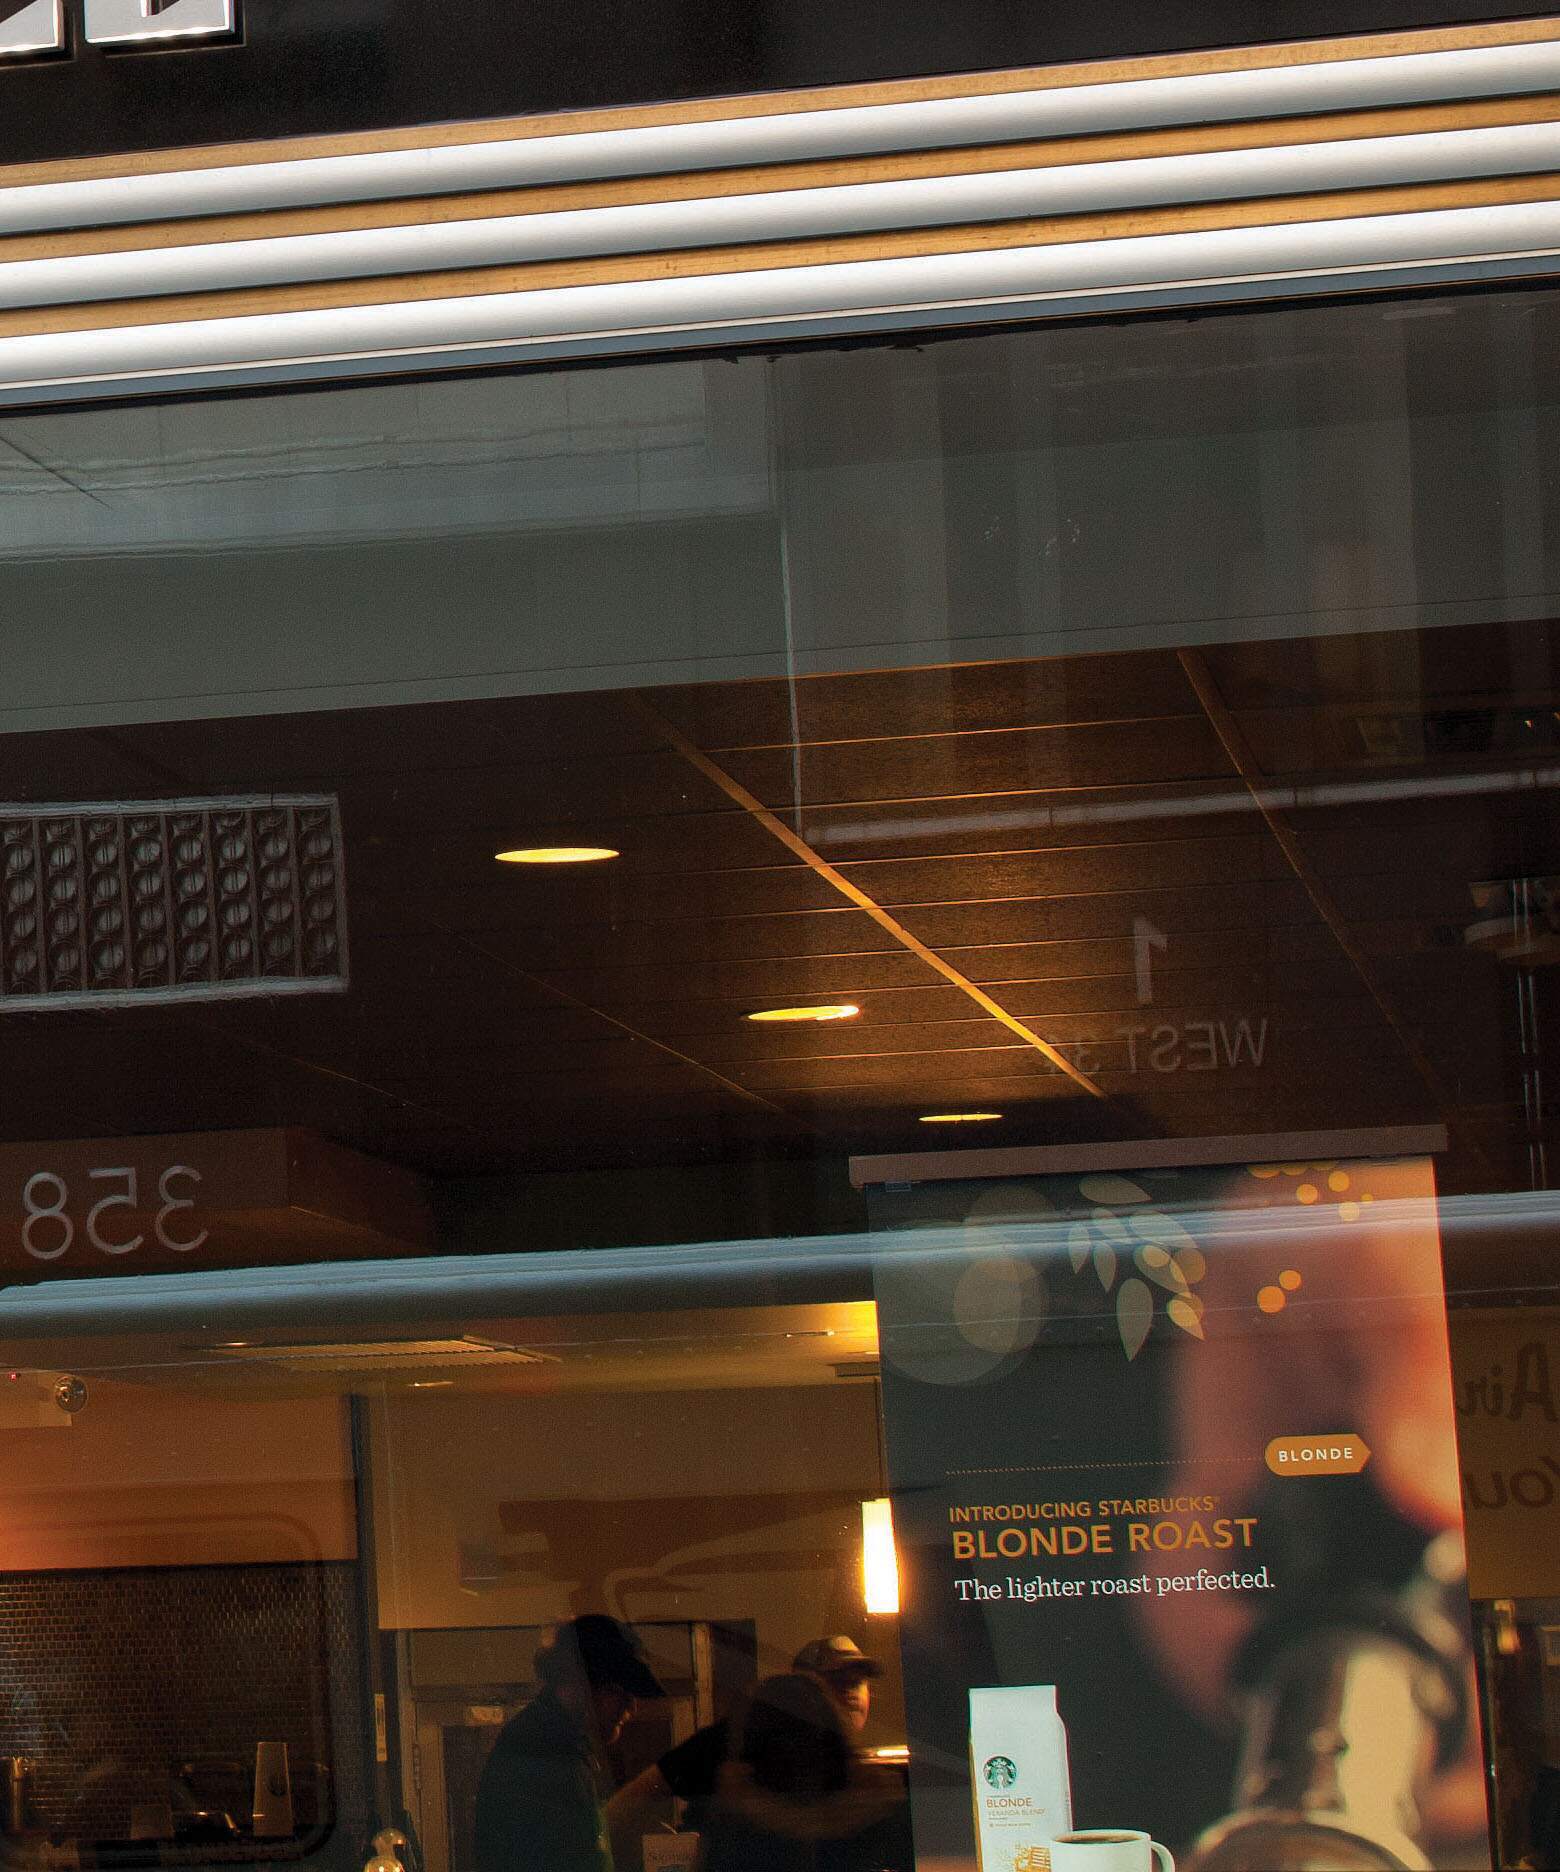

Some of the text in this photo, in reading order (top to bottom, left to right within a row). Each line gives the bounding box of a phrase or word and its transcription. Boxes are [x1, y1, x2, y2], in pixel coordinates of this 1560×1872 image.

[1278, 1446, 1355, 1463] BLONDE
[949, 1500, 1091, 1523] INTRODUCING
[952, 1517, 1258, 1560] BLONDE ROAST
[954, 1566, 1275, 1605] The lighter roast perfected.
[987, 1798, 1032, 1808] BLONDE
